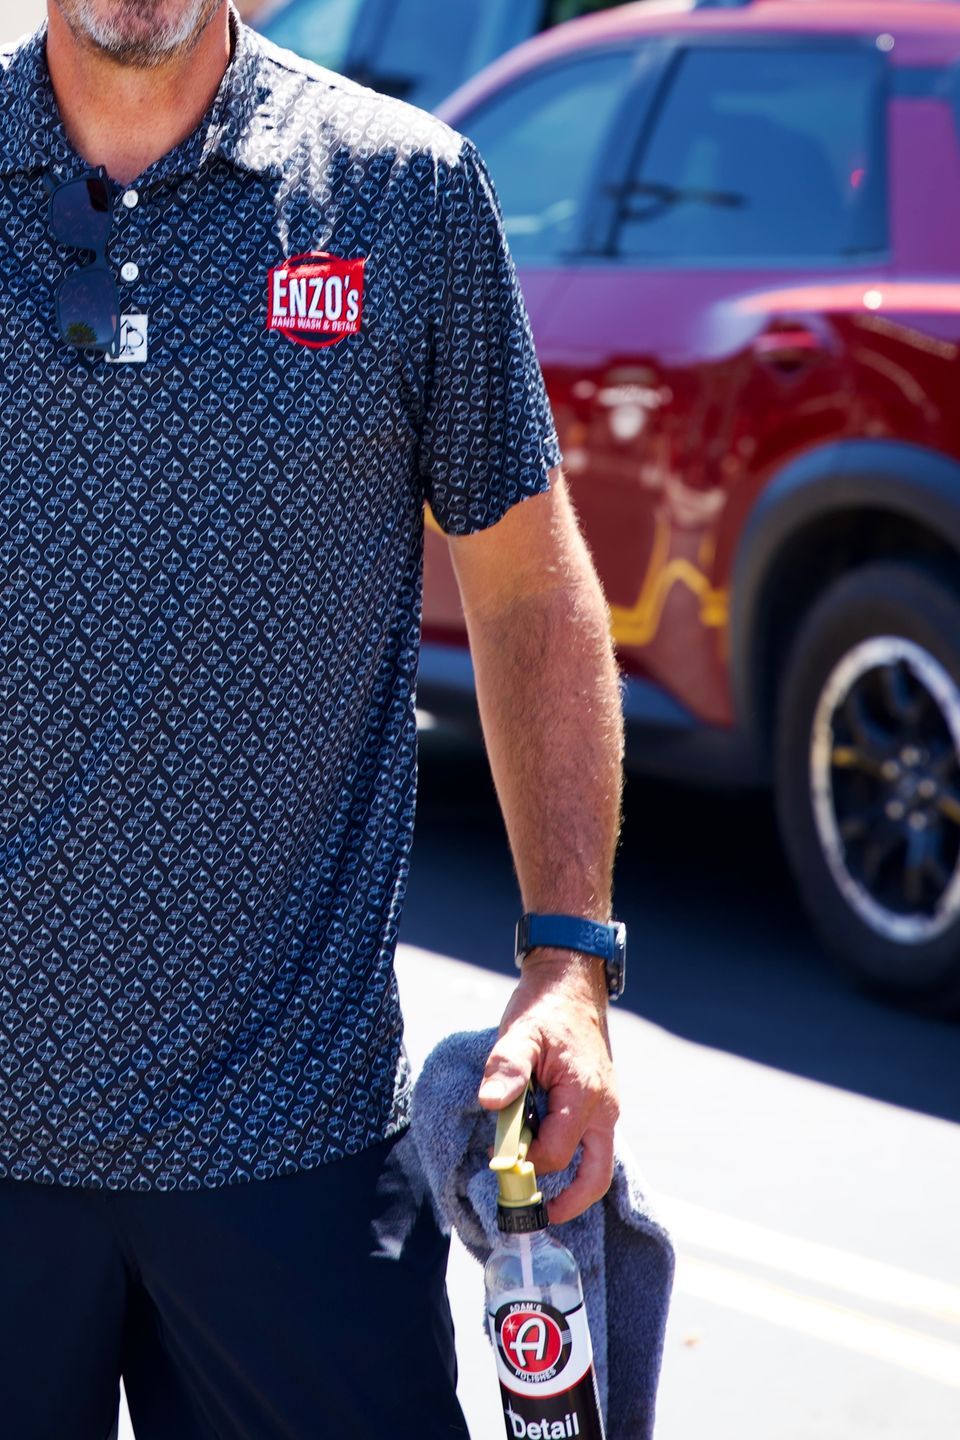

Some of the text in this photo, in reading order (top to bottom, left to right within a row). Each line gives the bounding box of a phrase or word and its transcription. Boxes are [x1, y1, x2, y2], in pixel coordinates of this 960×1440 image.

[271, 317, 295, 328] HAND
[298, 318, 322, 329] WASH
[510, 1302, 542, 1313] ADAM'S
[515, 1368, 557, 1383] POLISHES
[512, 1412, 580, 1440] Detail
